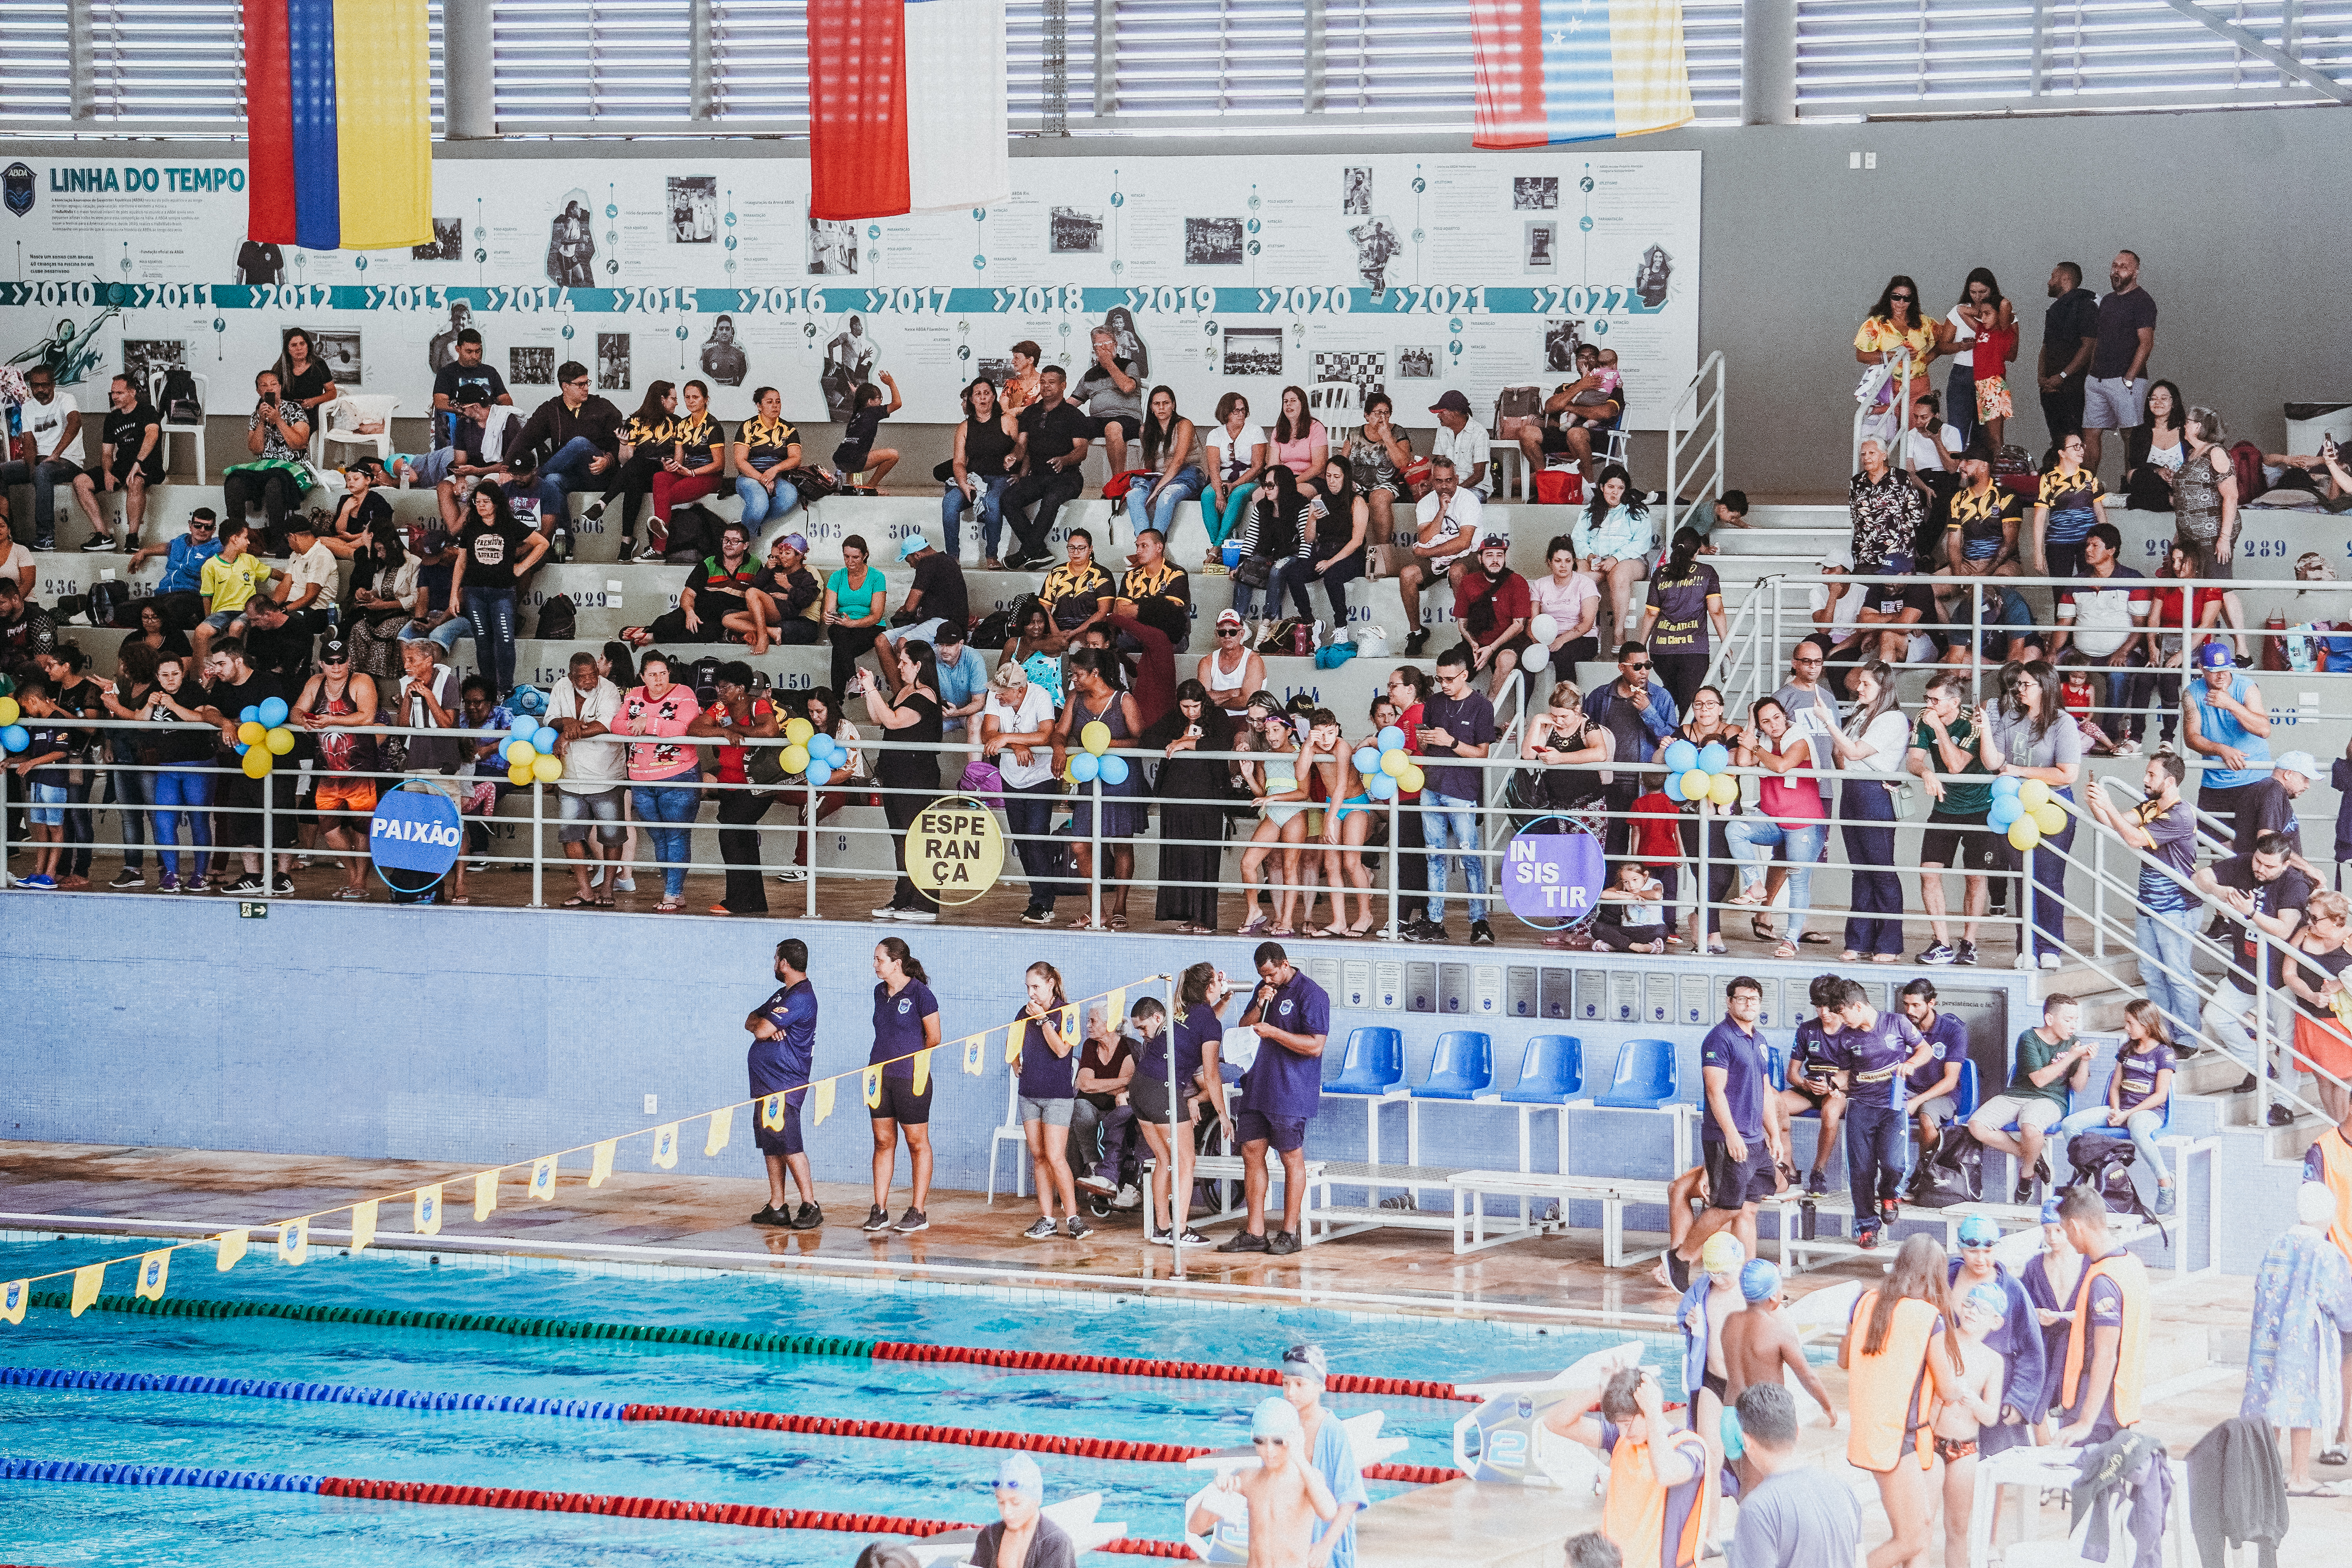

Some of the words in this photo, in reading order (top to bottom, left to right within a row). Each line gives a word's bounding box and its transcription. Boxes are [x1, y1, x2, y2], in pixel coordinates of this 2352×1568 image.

[50, 168, 119, 193] LINHA
[125, 168, 160, 193] DO
[164, 168, 245, 193] TEMPO
[21, 280, 95, 308] 2010
[142, 282, 219, 310] 2011
[258, 282, 334, 311] 2012
[377, 284, 448, 312] 2013
[497, 284, 575, 314] 2014
[625, 285, 698, 315] 2015
[749, 283, 827, 315] 2016
[877, 285, 953, 317] 2017
[1004, 283, 1084, 315] 2018
[1137, 285, 1216, 317] 2019
[1269, 285, 1352, 315] 2020
[1407, 285, 1490, 315] 2021
[1544, 285, 1629, 315] 2022
[809, 523, 841, 539] 303
[476, 539, 503, 547] PREMIUM
[2145, 539, 2171, 557] 29
[2244, 540, 2287, 557] 289
[45, 579, 77, 595] 236
[134, 582, 154, 597] 35
[522, 591, 543, 606] 30
[574, 592, 607, 607] 229
[1348, 605, 1370, 622] 20
[1677, 620, 1699, 631] ATLETA
[1668, 635, 1686, 644] Clara
[778, 673, 810, 689] 150
[371, 818, 460, 847] PAIXÃO
[921, 814, 985, 837] ESPE
[838, 835, 847, 851] 8
[926, 839, 980, 860] RAN
[1509, 840, 1536, 862] IN
[932, 861, 969, 886] ÇA
[1515, 861, 1559, 884] SIS
[1541, 885, 1587, 908] TIR
[1488, 1429, 1528, 1467] 2
